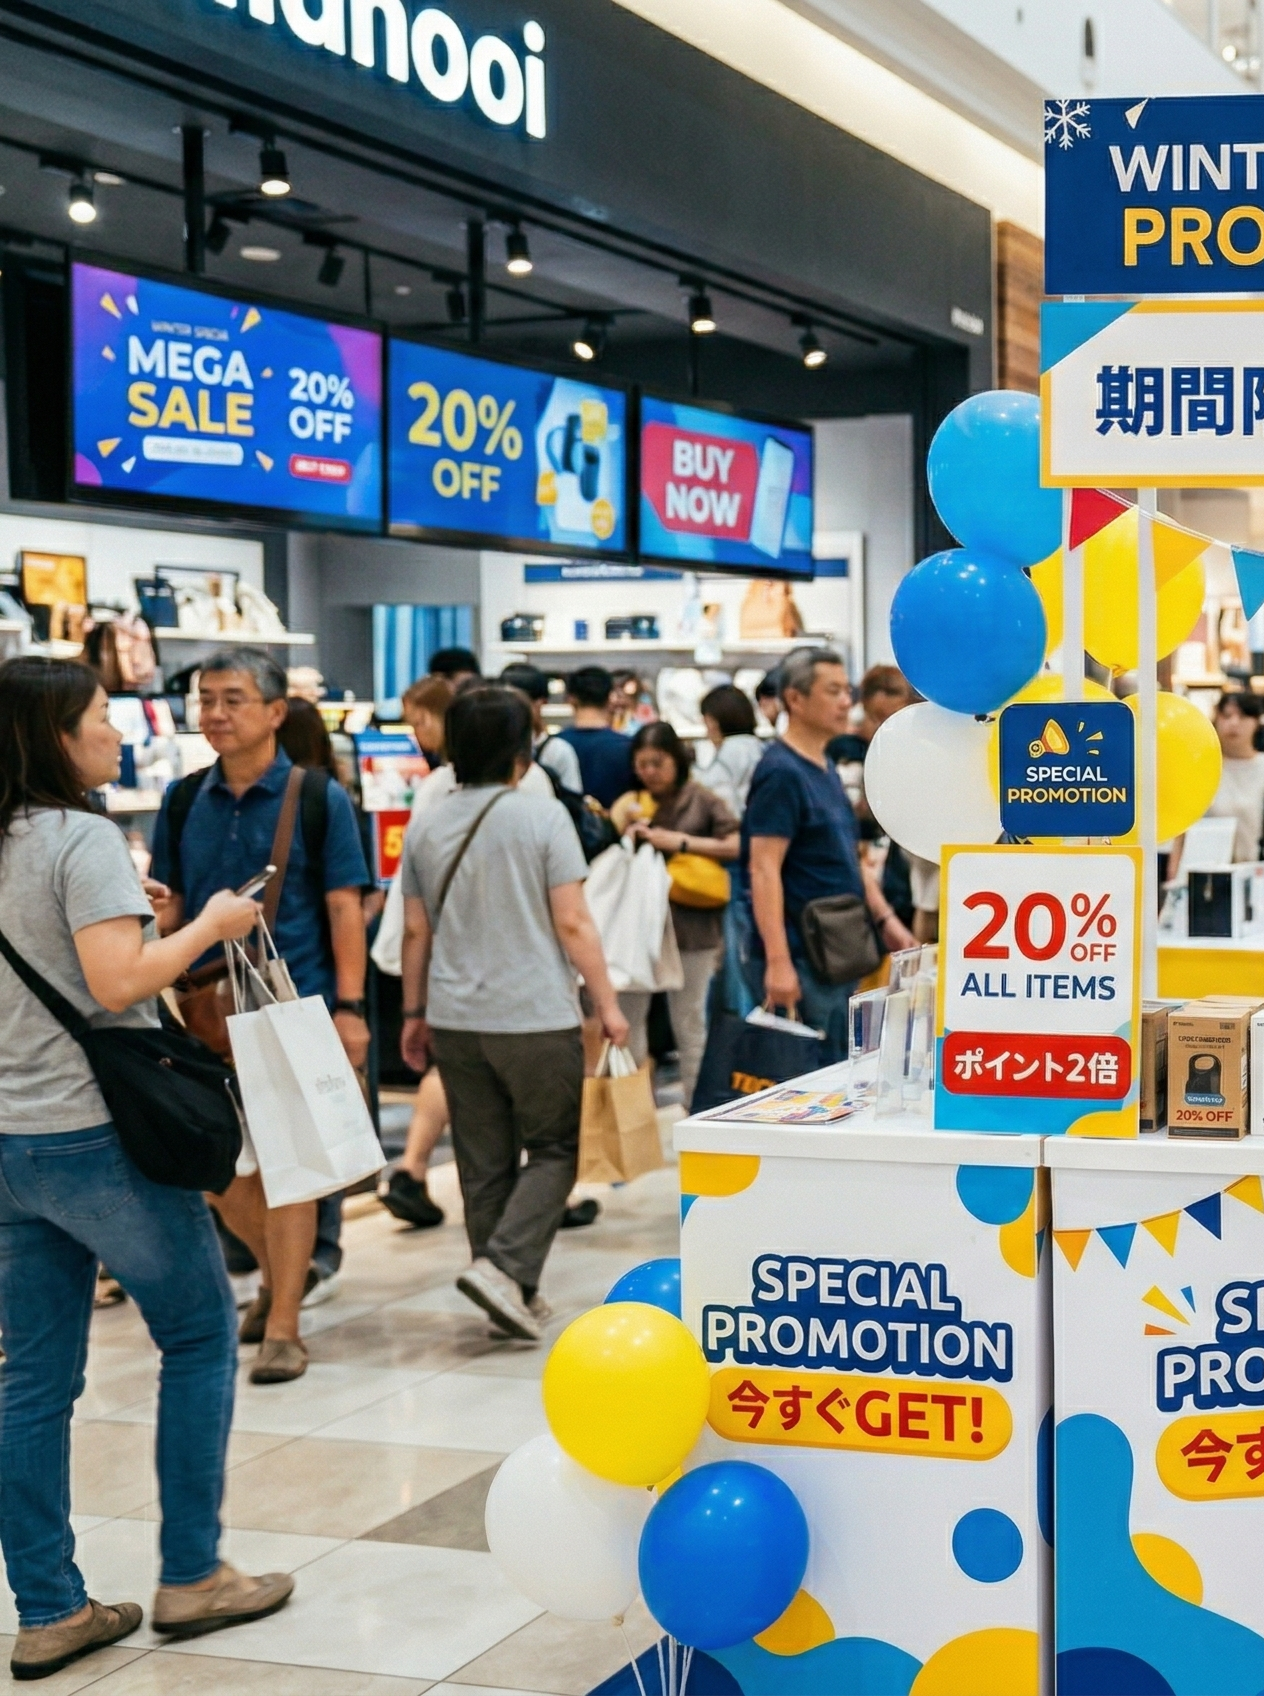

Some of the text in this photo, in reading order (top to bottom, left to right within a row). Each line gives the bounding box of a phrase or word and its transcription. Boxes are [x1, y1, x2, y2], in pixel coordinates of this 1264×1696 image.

[215, 0, 546, 139] anooi
[128, 335, 254, 390] MEGA
[128, 381, 254, 437] SALE
[288, 367, 354, 410] 20%
[288, 406, 353, 444] OFF
[407, 381, 523, 461] 20%
[432, 458, 501, 502] OFF
[672, 439, 734, 484] BUY
[665, 482, 742, 528] NOW
[1007, 787, 1127, 803] PROMOTION
[1026, 766, 1108, 782] SPECIAL
[962, 891, 1117, 961] 20%
[1070, 943, 1117, 962] OFF
[960, 972, 1116, 1000] ALL ITEMS
[953, 1047, 1119, 1085] ポイント2倍
[1176, 1110, 1233, 1122] 20% OFF
[757, 1260, 955, 1311] SPECIAL
[707, 1311, 1006, 1370] PROMOTION
[727, 1379, 983, 1444] 今すぐGET!
